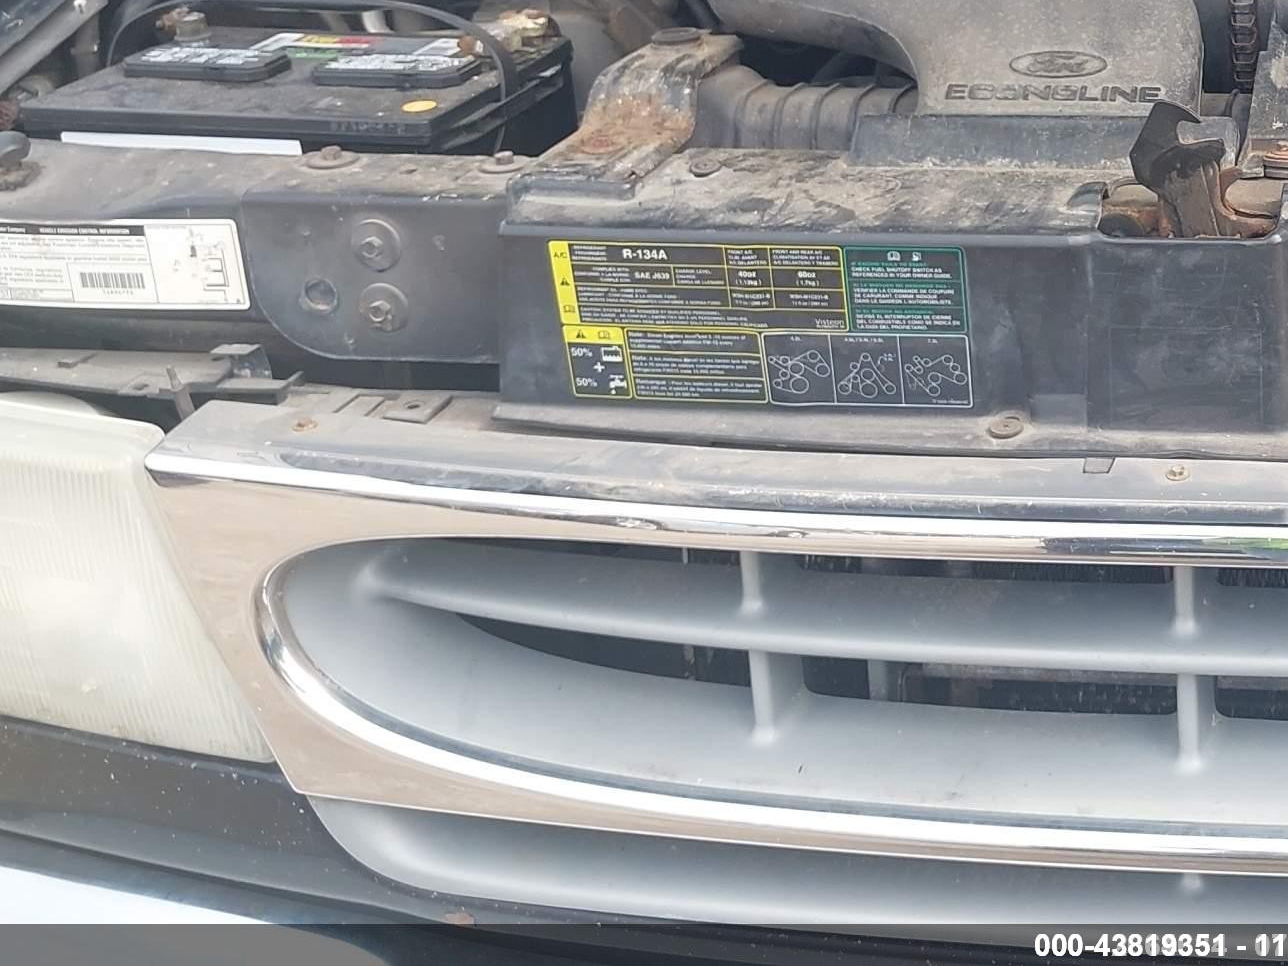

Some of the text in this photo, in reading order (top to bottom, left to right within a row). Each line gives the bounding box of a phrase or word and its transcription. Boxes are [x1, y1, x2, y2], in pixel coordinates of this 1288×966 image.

[1027, 54, 1086, 73] Ford
[945, 83, 1162, 102] ECONOLINE
[622, 249, 668, 260] R-134A
[571, 347, 593, 356] 50%
[576, 378, 597, 387] 50%
